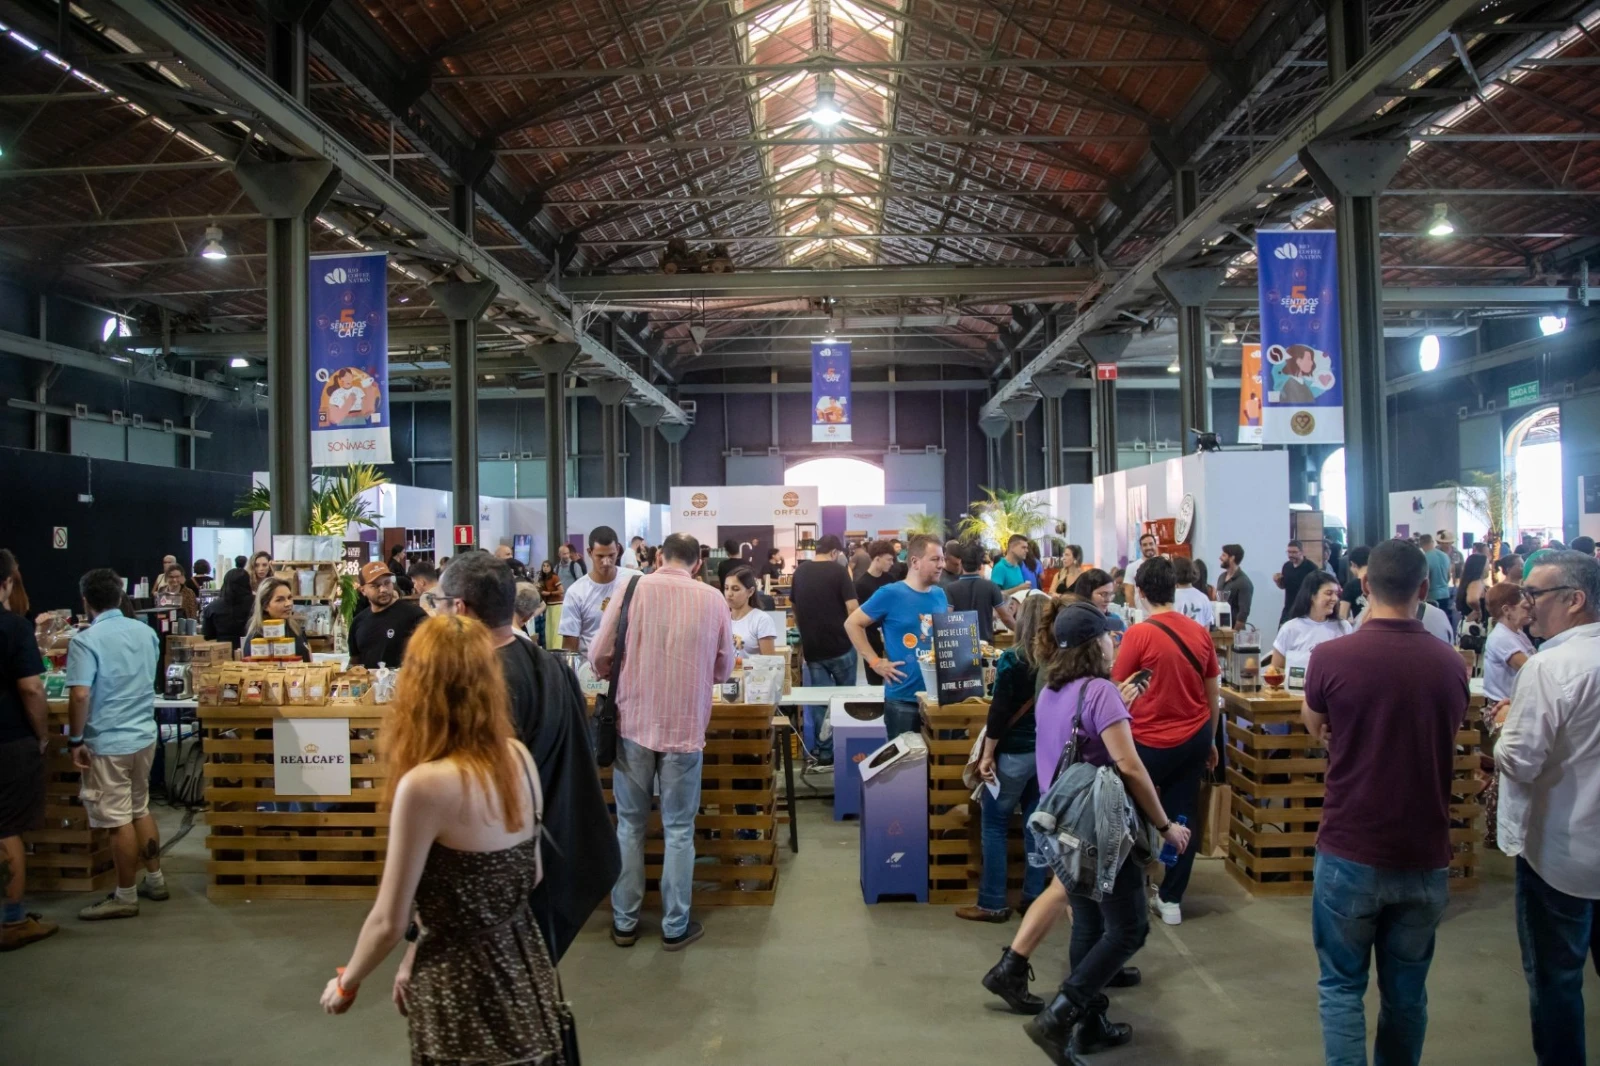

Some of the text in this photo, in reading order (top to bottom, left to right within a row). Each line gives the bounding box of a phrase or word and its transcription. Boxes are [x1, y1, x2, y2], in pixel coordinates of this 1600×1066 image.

[1280, 297, 1319, 306] SENTIDOS
[1291, 285, 1307, 307] 5
[330, 321, 367, 330] SENTIDOS
[340, 309, 355, 332] 5
